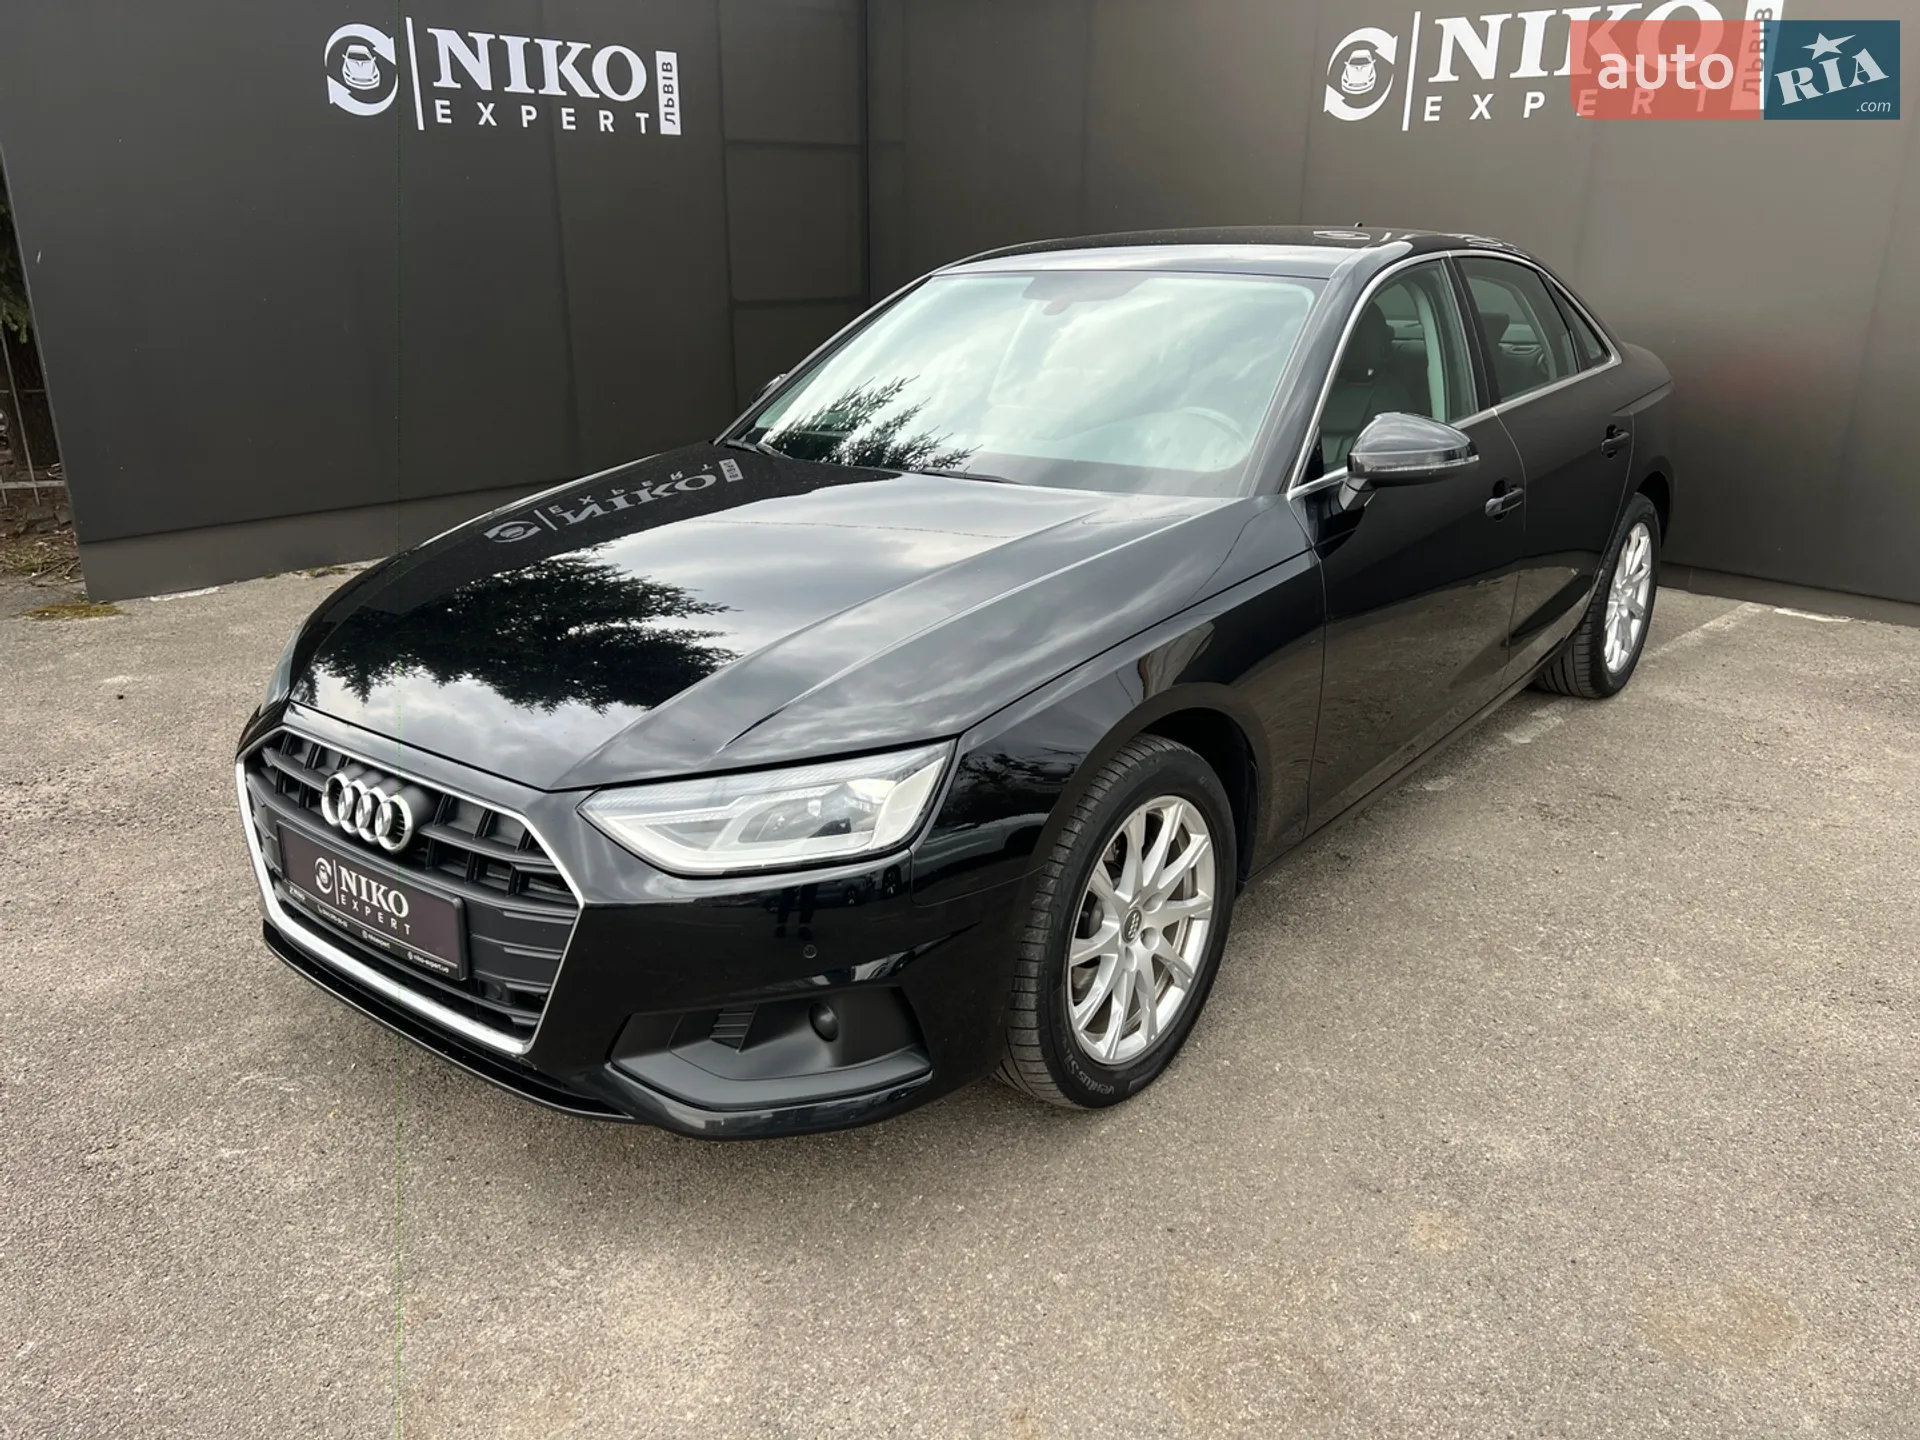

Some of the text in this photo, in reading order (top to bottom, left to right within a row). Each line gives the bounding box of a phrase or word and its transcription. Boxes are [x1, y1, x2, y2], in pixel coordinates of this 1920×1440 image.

[427, 28, 647, 101] NIKO
[1428, 0, 1724, 83] NIKO
[435, 100, 649, 133] EXPERT
[662, 61, 676, 124] ЛЬВІВ
[1423, 83, 1709, 122] EXPERT
[338, 866, 409, 918] NIKO
[340, 894, 411, 935] EXPERT
